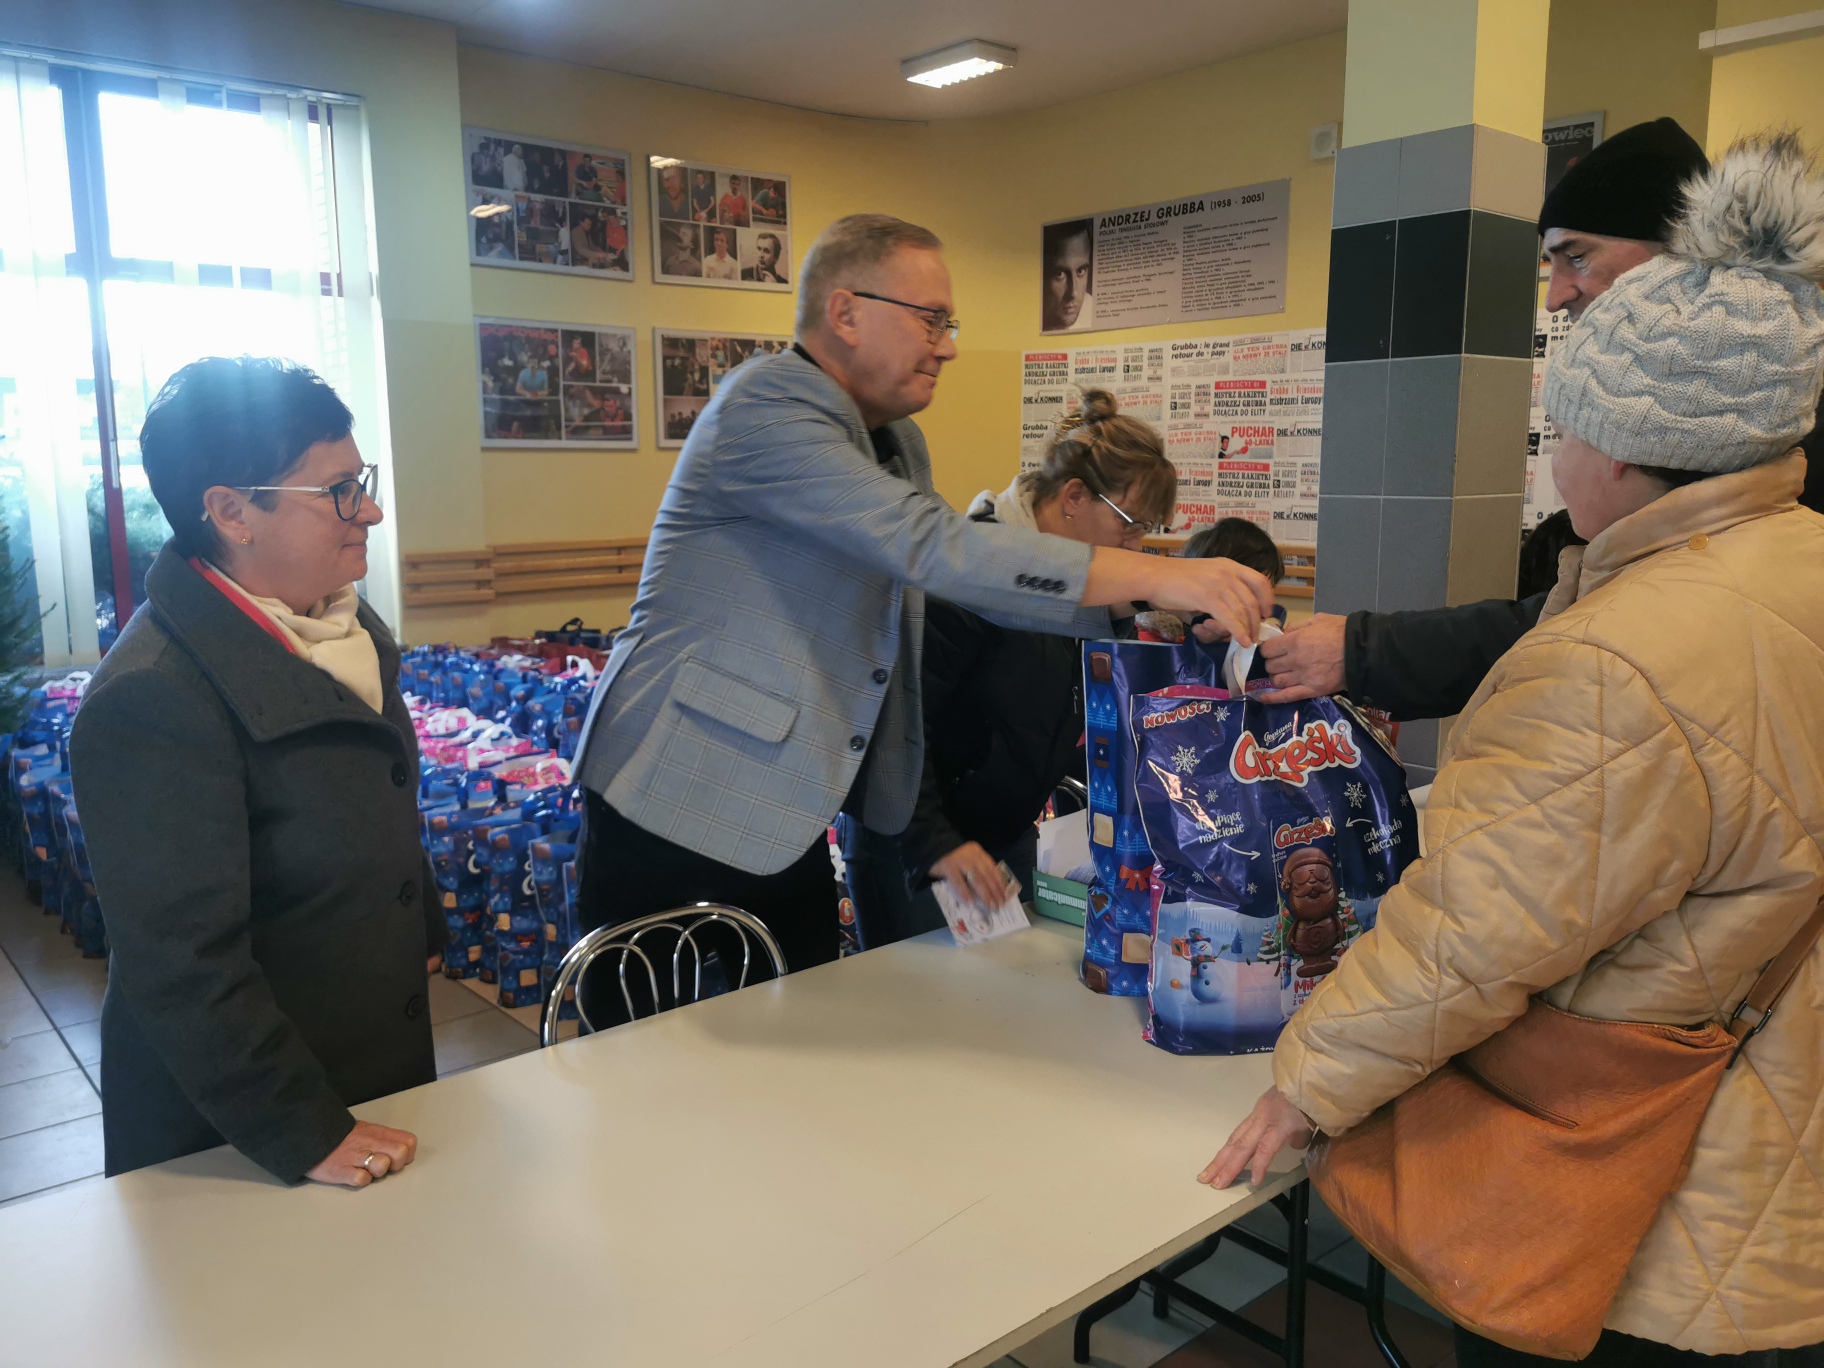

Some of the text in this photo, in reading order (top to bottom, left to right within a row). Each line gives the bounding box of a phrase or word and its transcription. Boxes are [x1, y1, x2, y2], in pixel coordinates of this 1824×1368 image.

[1100, 210, 1151, 229] ANDRZEJ
[1157, 200, 1205, 220] GRUBBA
[1210, 199, 1231, 210] (1958
[1241, 192, 1265, 204] 2005)
[1119, 225, 1142, 234] TENISISTA
[1552, 315, 1558, 323] O
[1172, 343, 1197, 351] Grubba
[1212, 341, 1230, 350] grand
[1291, 343, 1302, 351] DIE
[1270, 387, 1288, 395] Grubba
[1270, 396, 1298, 405] mistrzami
[1213, 409, 1238, 417] DOŁĄCZA
[1251, 408, 1265, 416] ELITY
[1231, 426, 1274, 438] PUCHAR
[1277, 428, 1288, 436] DIE
[1241, 473, 1271, 481] RAKIETKI
[1246, 481, 1270, 489] GRUBBA
[1217, 489, 1242, 498] DOŁĄCZA
[1176, 503, 1215, 515] PUCHAR
[1274, 511, 1284, 519] DIE
[1231, 720, 1360, 786] Grześki
[1363, 818, 1403, 843] czekolada
[1367, 834, 1401, 855] mleczna
